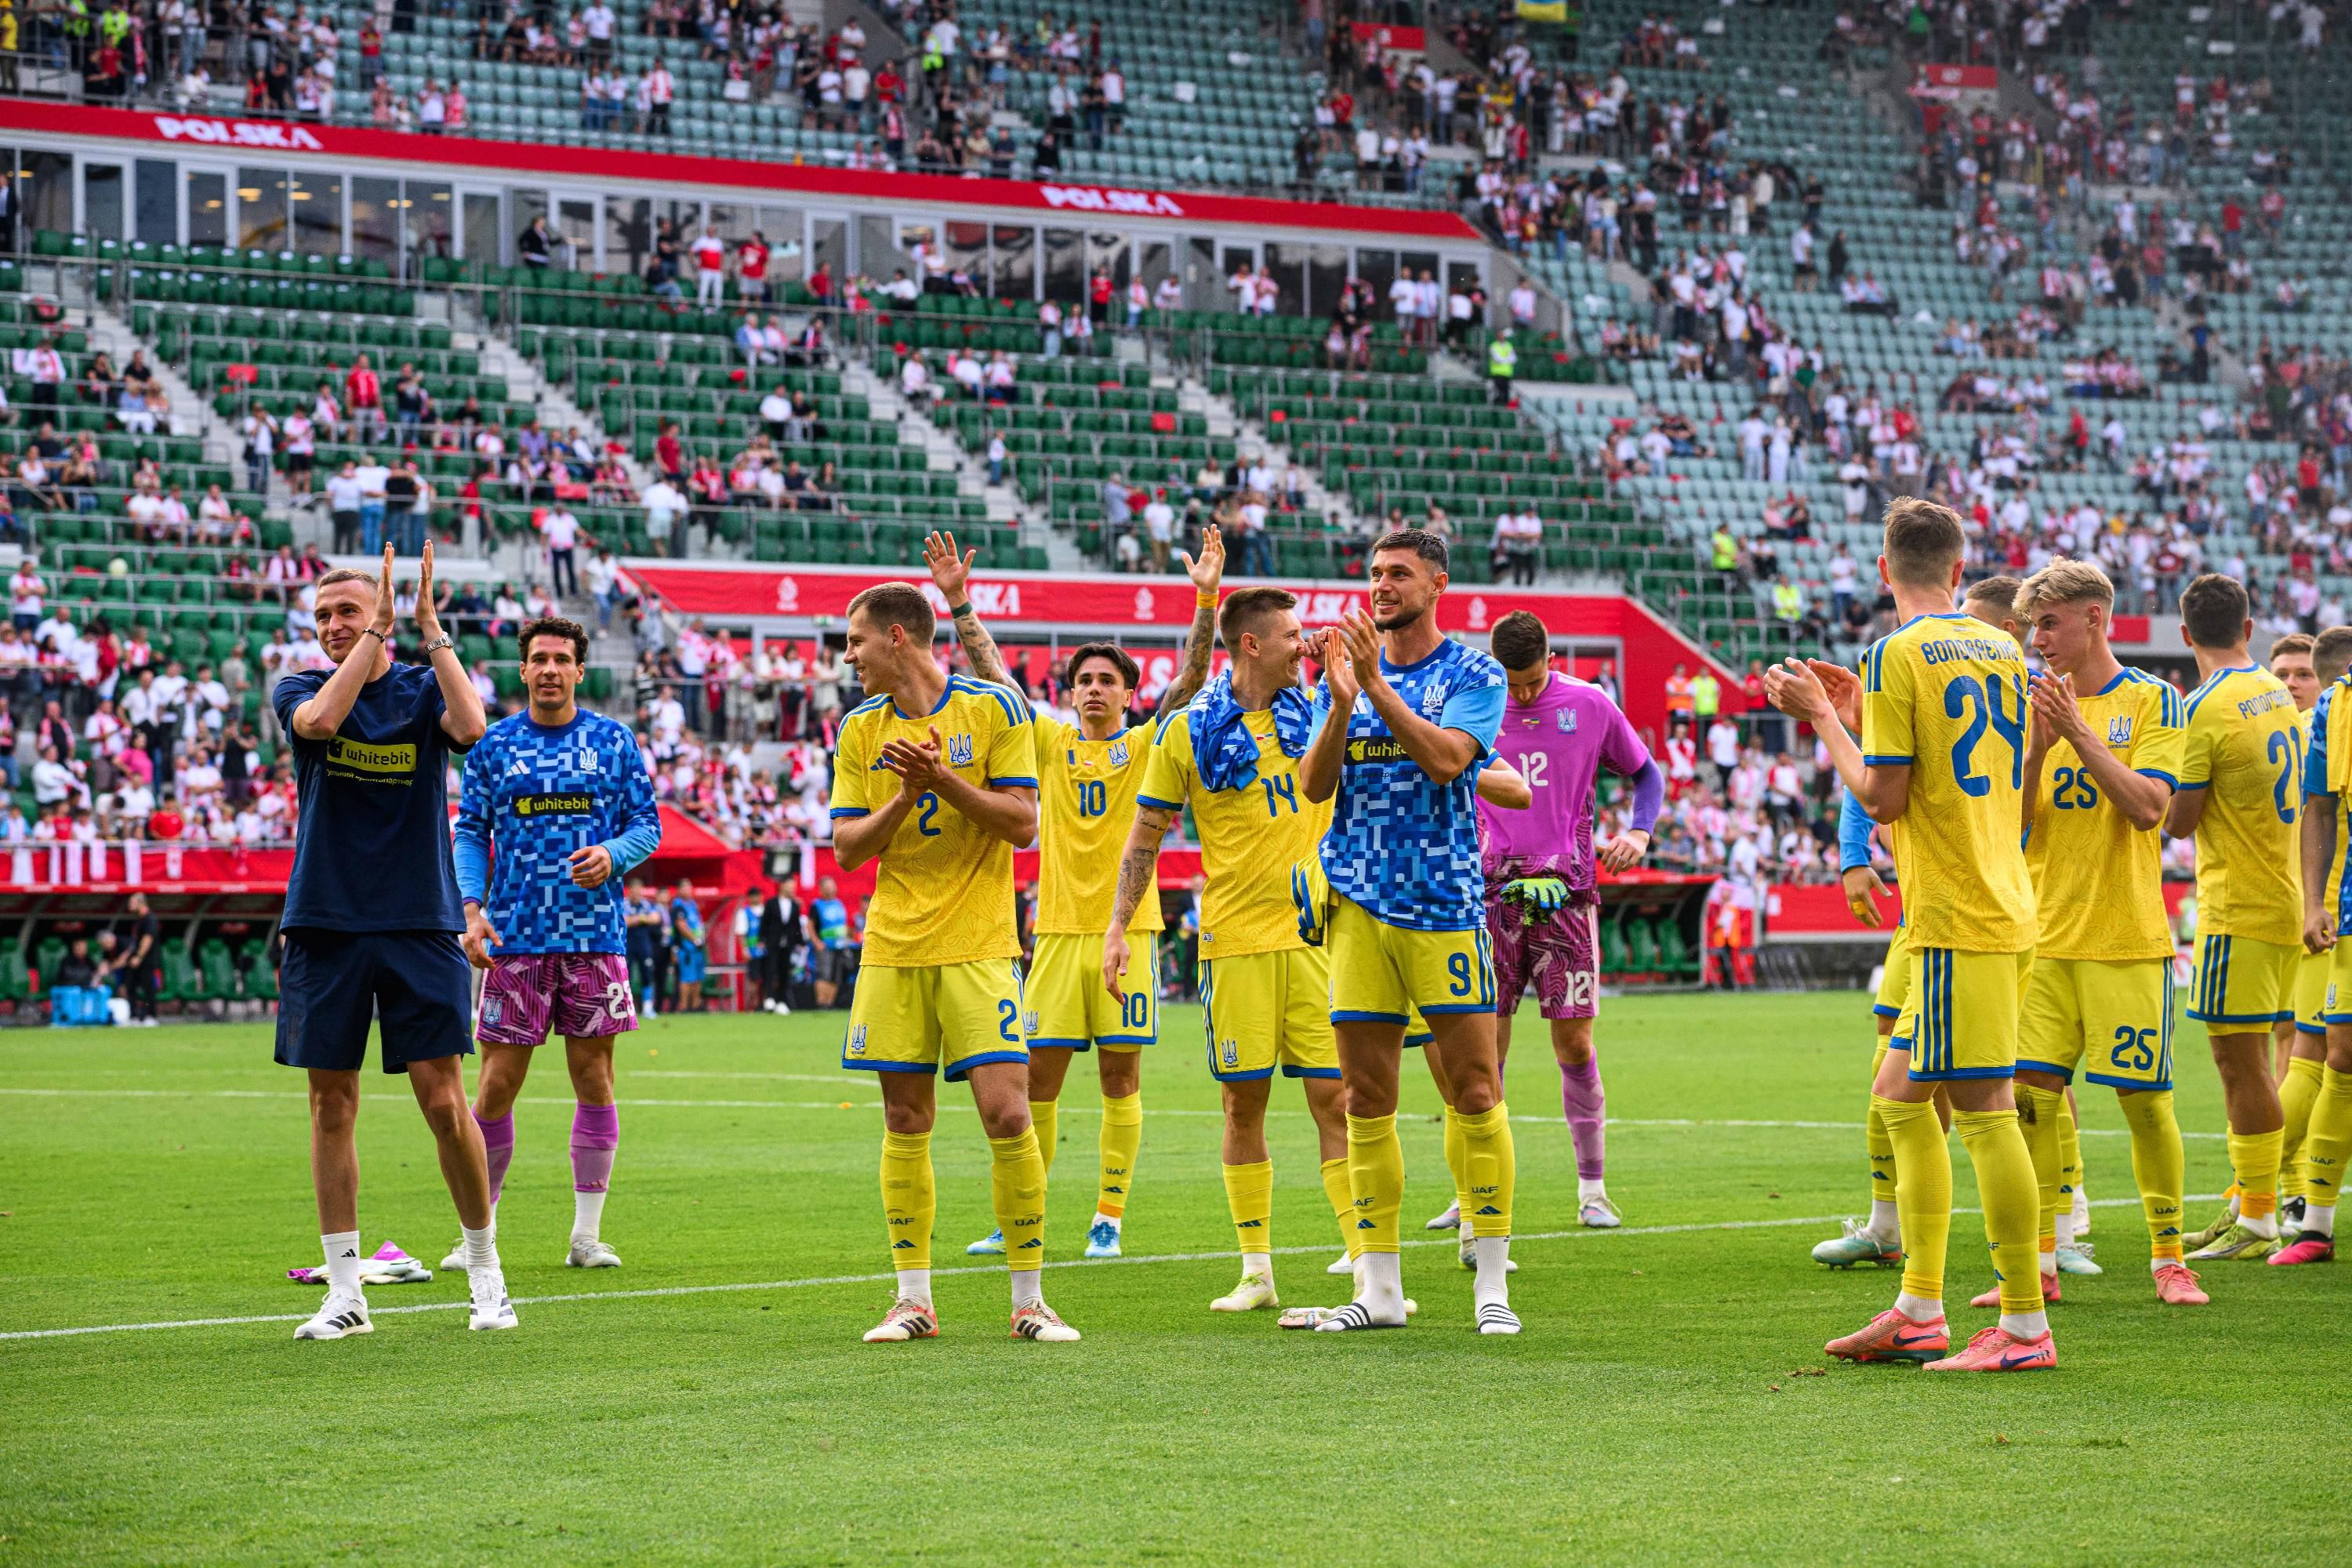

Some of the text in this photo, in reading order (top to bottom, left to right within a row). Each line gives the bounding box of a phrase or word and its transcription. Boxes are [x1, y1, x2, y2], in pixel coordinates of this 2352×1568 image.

[154, 117, 323, 150] POLSKA
[1040, 186, 1185, 216] POLSKA
[1944, 673, 2027, 797] 24
[347, 749, 411, 765] whitebit
[1519, 752, 1549, 786] 12
[2053, 767, 2097, 809] 25
[2267, 726, 2303, 824] 21
[534, 797, 590, 811] whitebit
[1078, 780, 1106, 816] 10
[1261, 773, 1298, 817] 14
[916, 792, 941, 837] 2
[1448, 953, 1472, 996] 9
[1565, 971, 1590, 1006] 12
[998, 999, 1019, 1042] 2
[1123, 992, 1147, 1028] 10
[2111, 1025, 2158, 1071] 25
[1105, 1167, 1127, 1175] UAF
[2310, 1156, 2336, 1165] UAF
[1472, 1185, 1498, 1194] UAF
[887, 1217, 915, 1225] UAF
[1014, 1216, 1044, 1226] UAF
[2154, 1206, 2179, 1214] UAF
